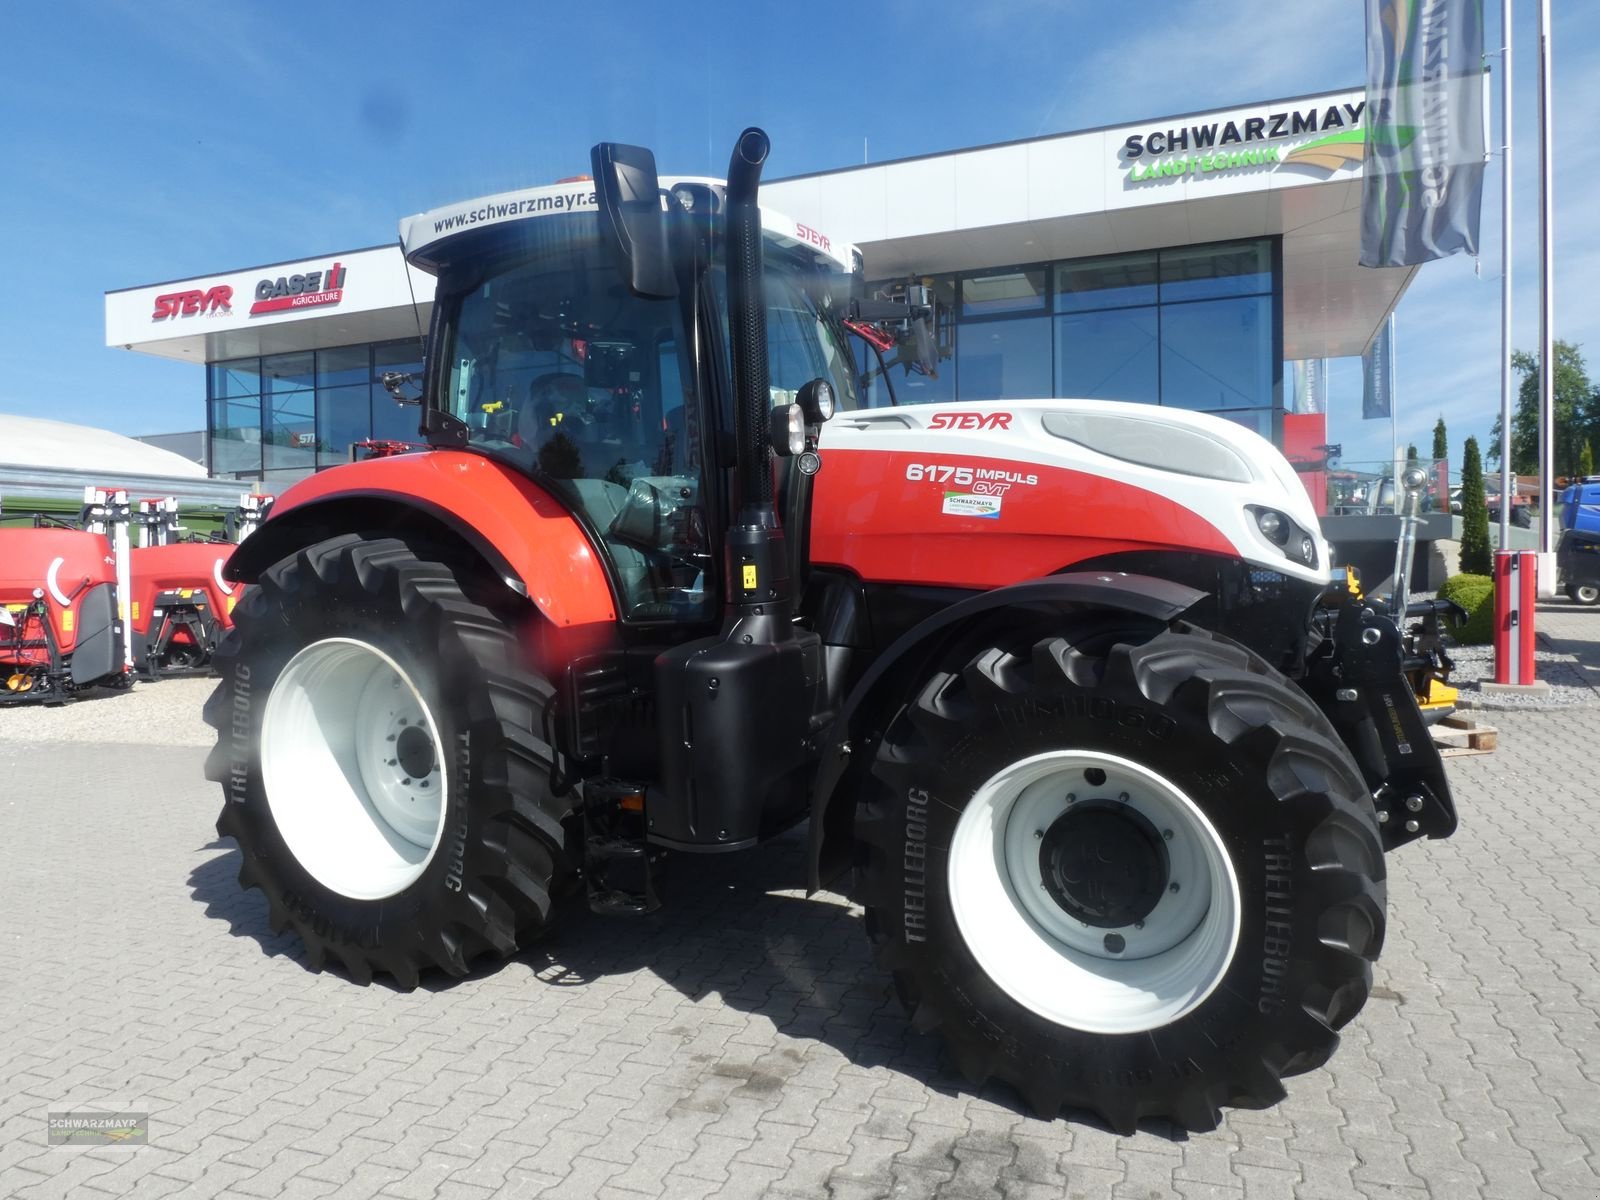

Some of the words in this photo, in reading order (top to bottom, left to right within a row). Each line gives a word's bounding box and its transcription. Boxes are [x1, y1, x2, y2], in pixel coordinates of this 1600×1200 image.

[1130, 145, 1281, 182] LANDTECHNIK
[434, 191, 598, 234] www.schwarzmayr.a
[796, 222, 831, 252] STEYR
[255, 271, 323, 300] CASE
[291, 291, 340, 307] AGRICULTURE
[151, 285, 234, 319] STEYR
[926, 411, 1013, 431] STEYR
[905, 463, 974, 486] 6175
[975, 468, 1039, 486] IMPULS
[949, 497, 993, 507] SCHWARZMAYR
[972, 482, 1011, 497] CVT
[904, 787, 930, 945] TRELLEBORG
